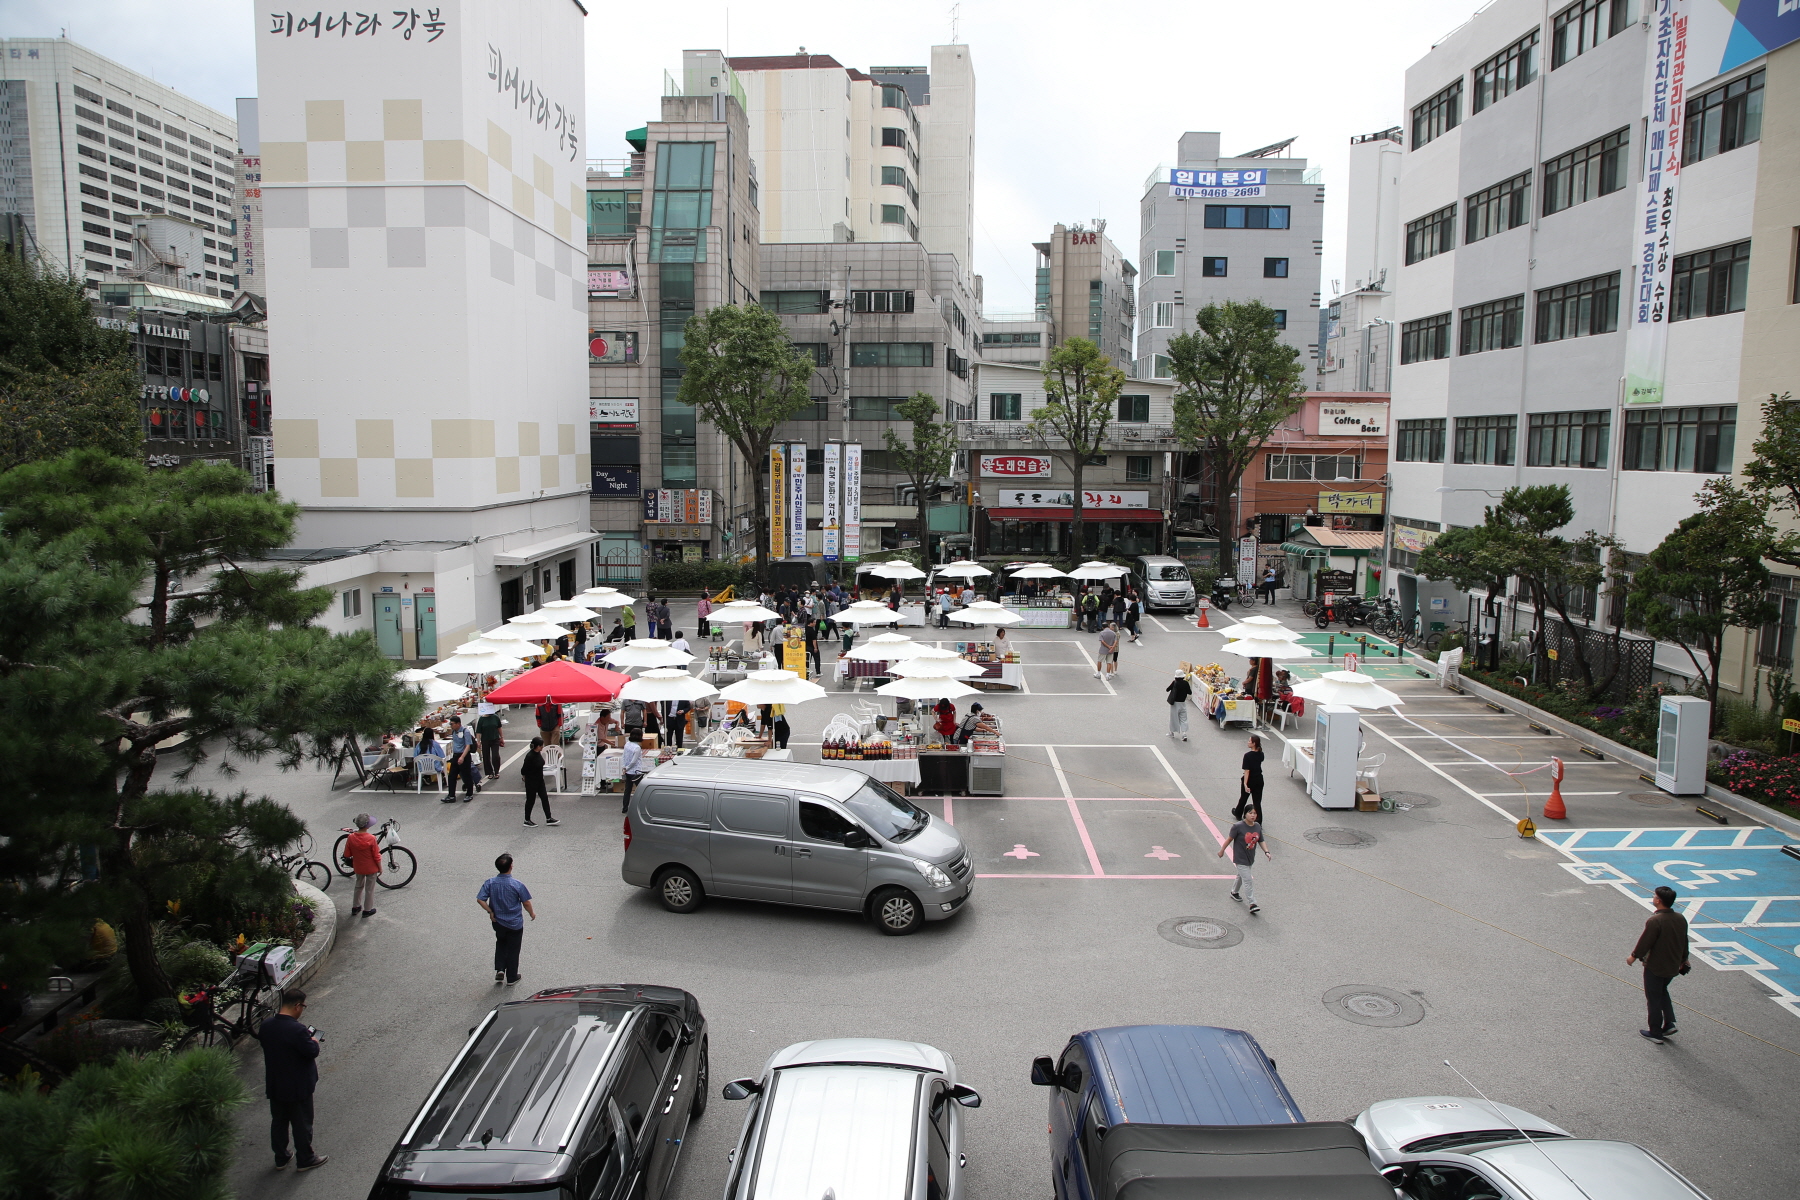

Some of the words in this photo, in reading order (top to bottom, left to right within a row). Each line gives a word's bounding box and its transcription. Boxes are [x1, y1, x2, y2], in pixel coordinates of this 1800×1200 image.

[269, 11, 382, 38] 피어나라
[392, 7, 446, 43] 강북
[1652, 0, 1673, 123] 기초자치단체
[487, 41, 551, 131] 피어나라
[554, 101, 579, 163] 강북
[1175, 170, 1262, 187] 임대문의
[1644, 129, 1665, 235] 매니페스토
[1174, 187, 1260, 198] 010-9468-2699
[1072, 233, 1097, 245] BAR
[1657, 186, 1674, 274] 최우수상
[1637, 241, 1656, 324] 경진대회
[1651, 282, 1666, 324] 수상
[143, 323, 191, 341] VILLAIN
[1334, 417, 1361, 425] Coffee
[1369, 417, 1376, 425] &
[1361, 424, 1381, 433] Beer
[828, 466, 836, 480] 한국
[609, 482, 628, 490] Night
[794, 479, 803, 530] 민주시민골든벨
[828, 503, 836, 517] 역사
